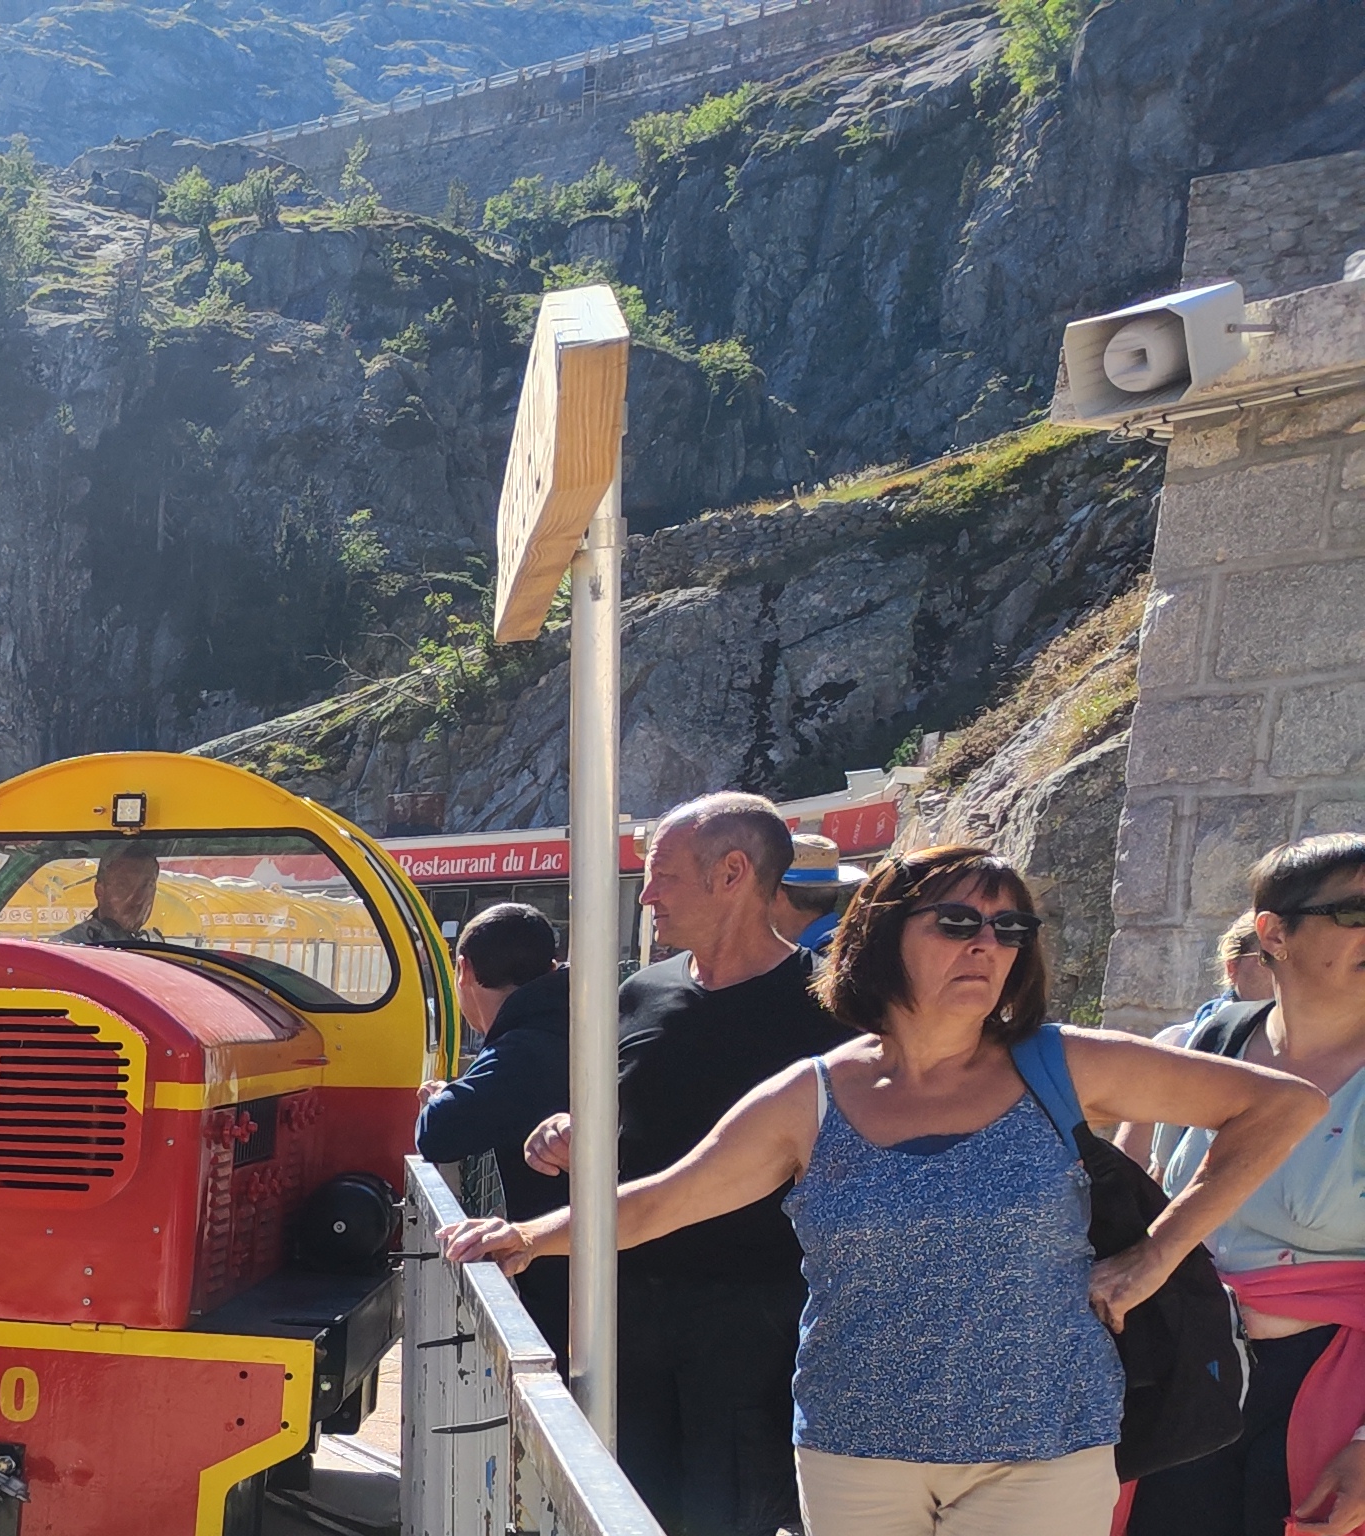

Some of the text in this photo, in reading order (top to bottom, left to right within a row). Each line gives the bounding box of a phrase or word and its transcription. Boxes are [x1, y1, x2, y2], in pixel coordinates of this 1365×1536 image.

[399, 847, 563, 877] Restaurant du Lac
